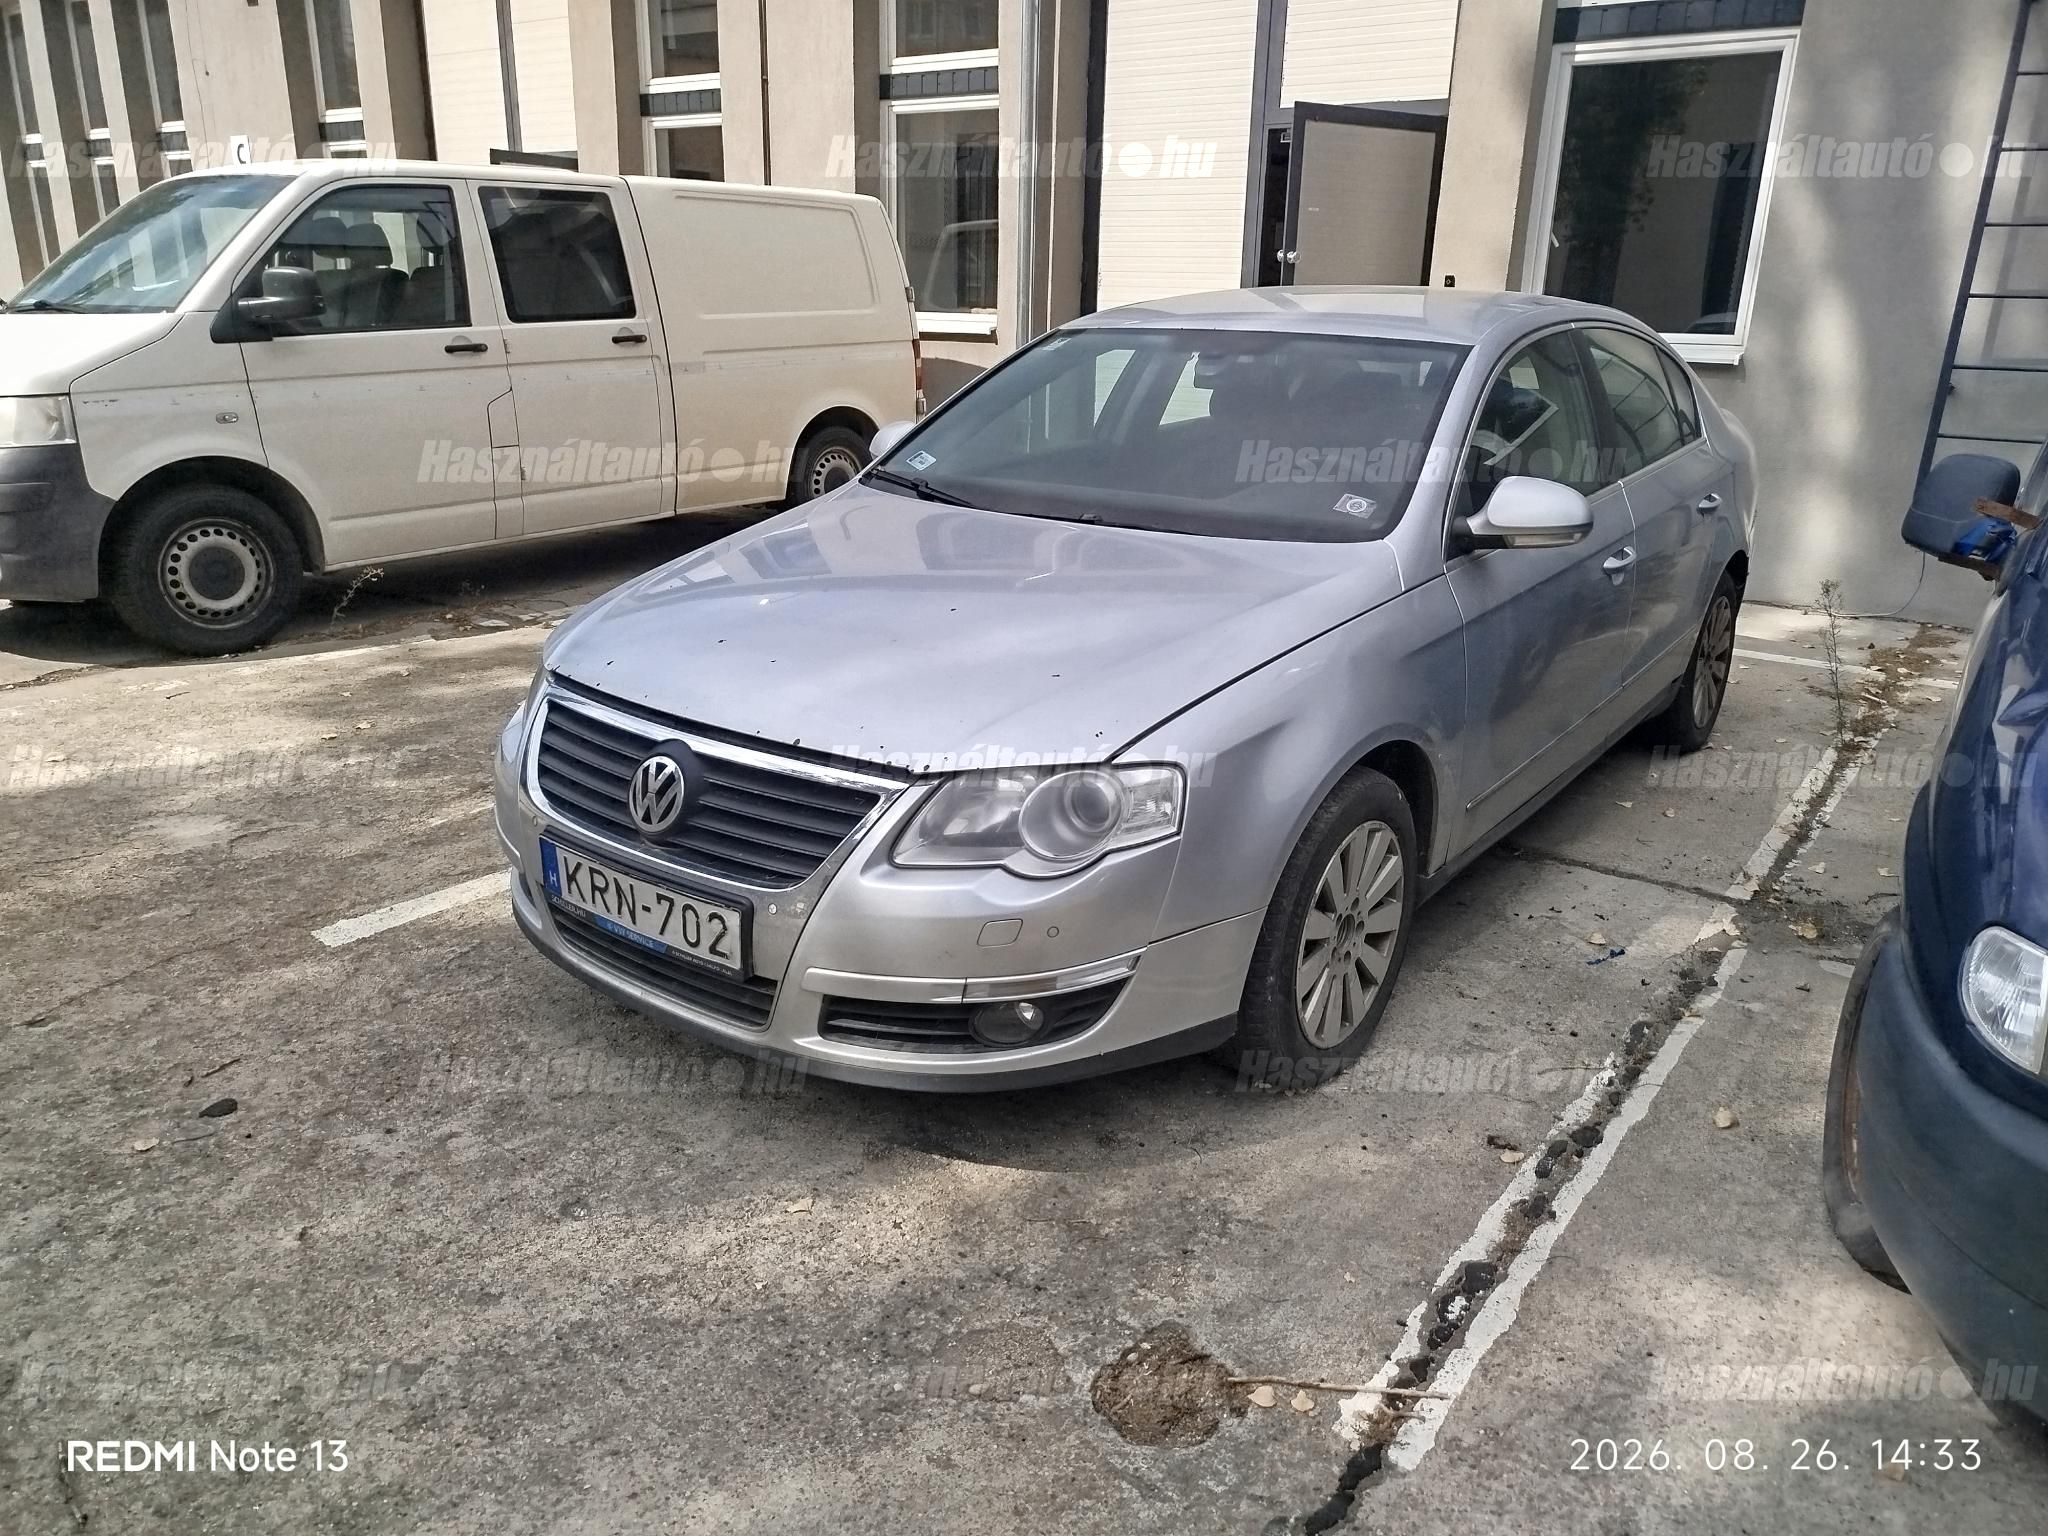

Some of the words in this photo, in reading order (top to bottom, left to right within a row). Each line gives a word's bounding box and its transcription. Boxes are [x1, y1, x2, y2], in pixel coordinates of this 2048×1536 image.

[236, 143, 247, 165] C
[548, 870, 558, 884] H
[562, 855, 731, 961] KRN-702
